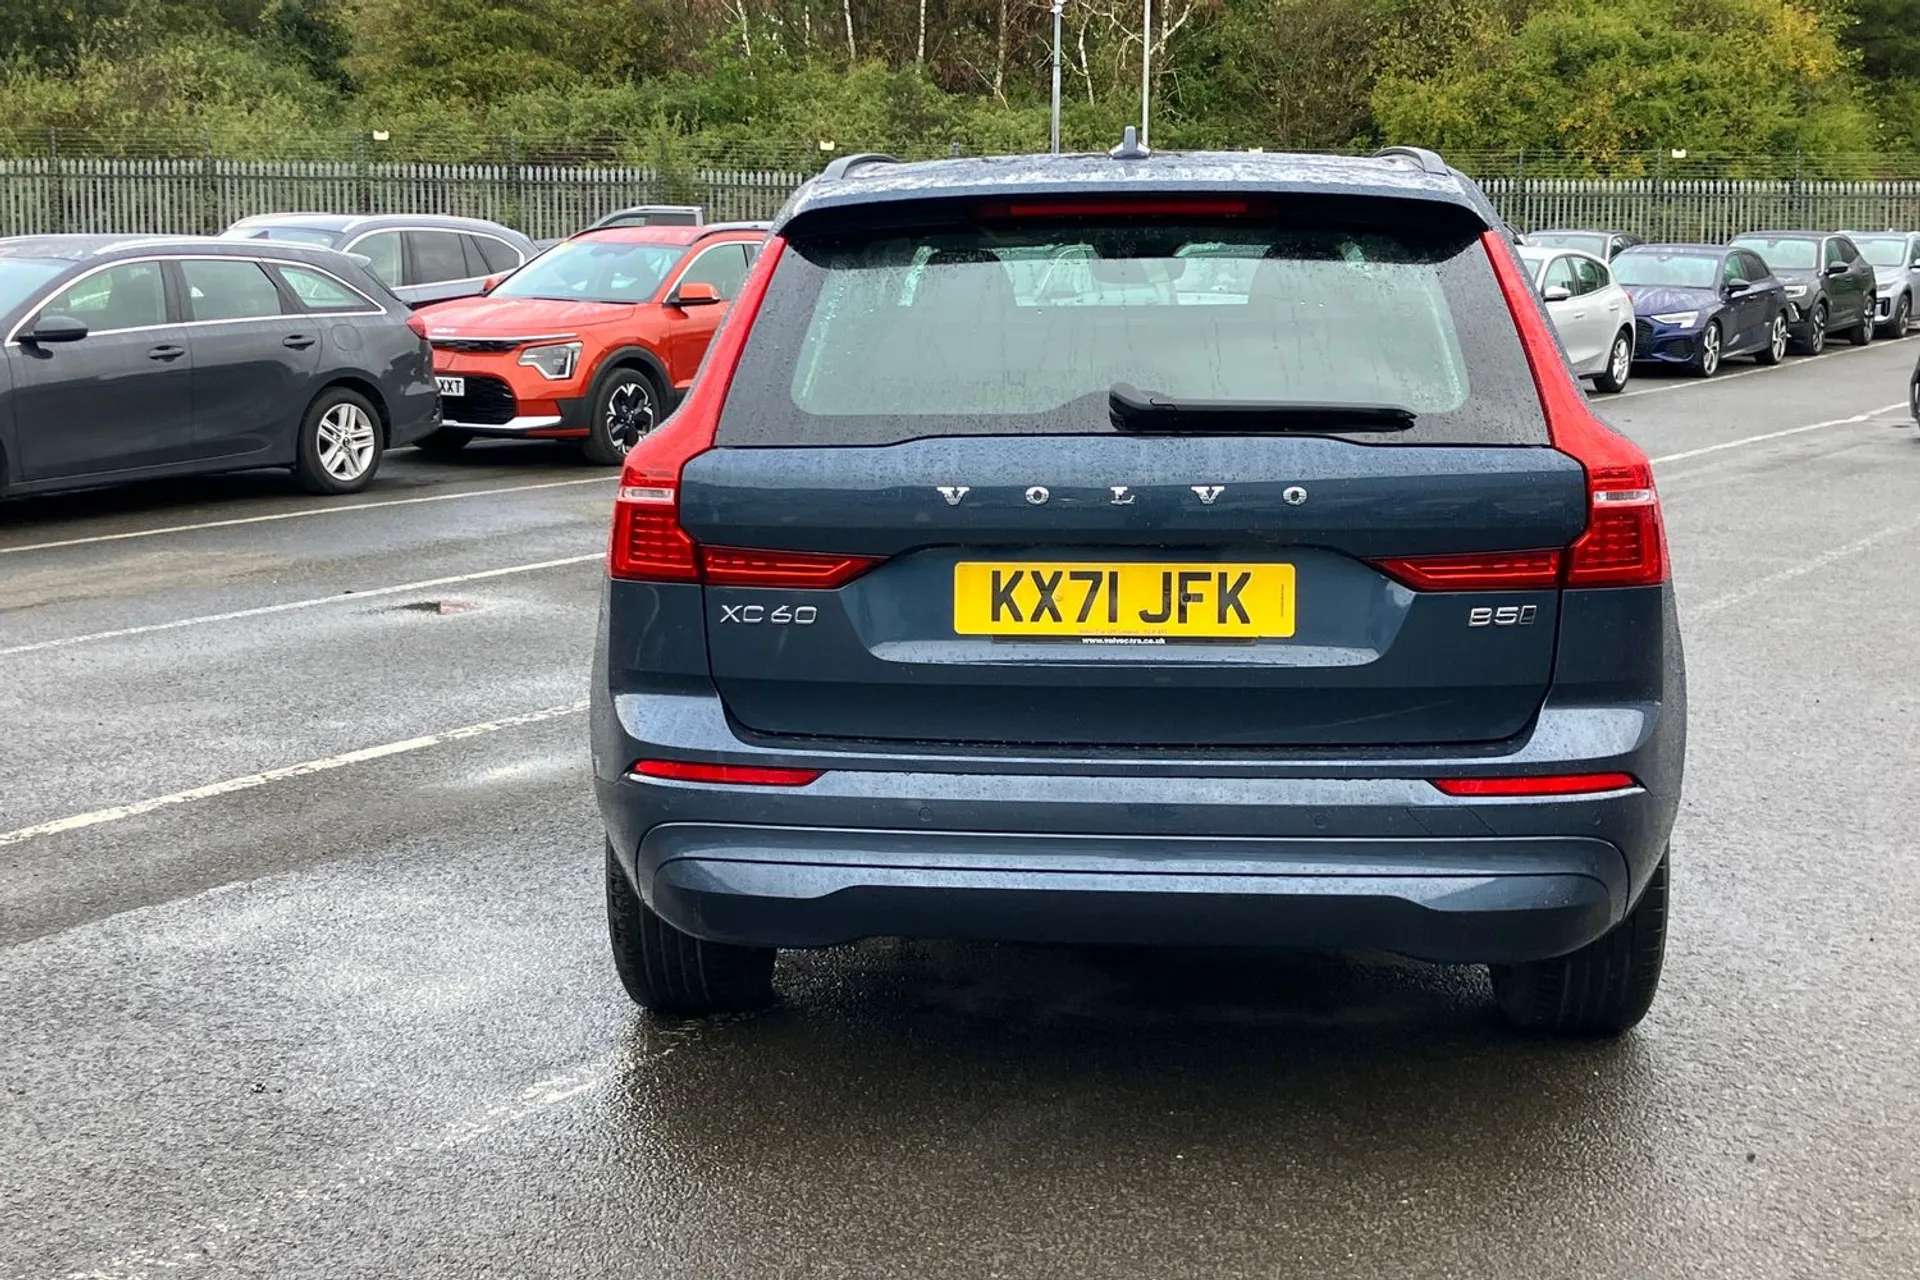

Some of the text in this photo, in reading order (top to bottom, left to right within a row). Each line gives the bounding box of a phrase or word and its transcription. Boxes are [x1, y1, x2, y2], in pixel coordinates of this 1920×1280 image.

[936, 485, 1308, 506] VOLVO
[991, 570, 1119, 623] KX71
[1138, 571, 1252, 624] JFK
